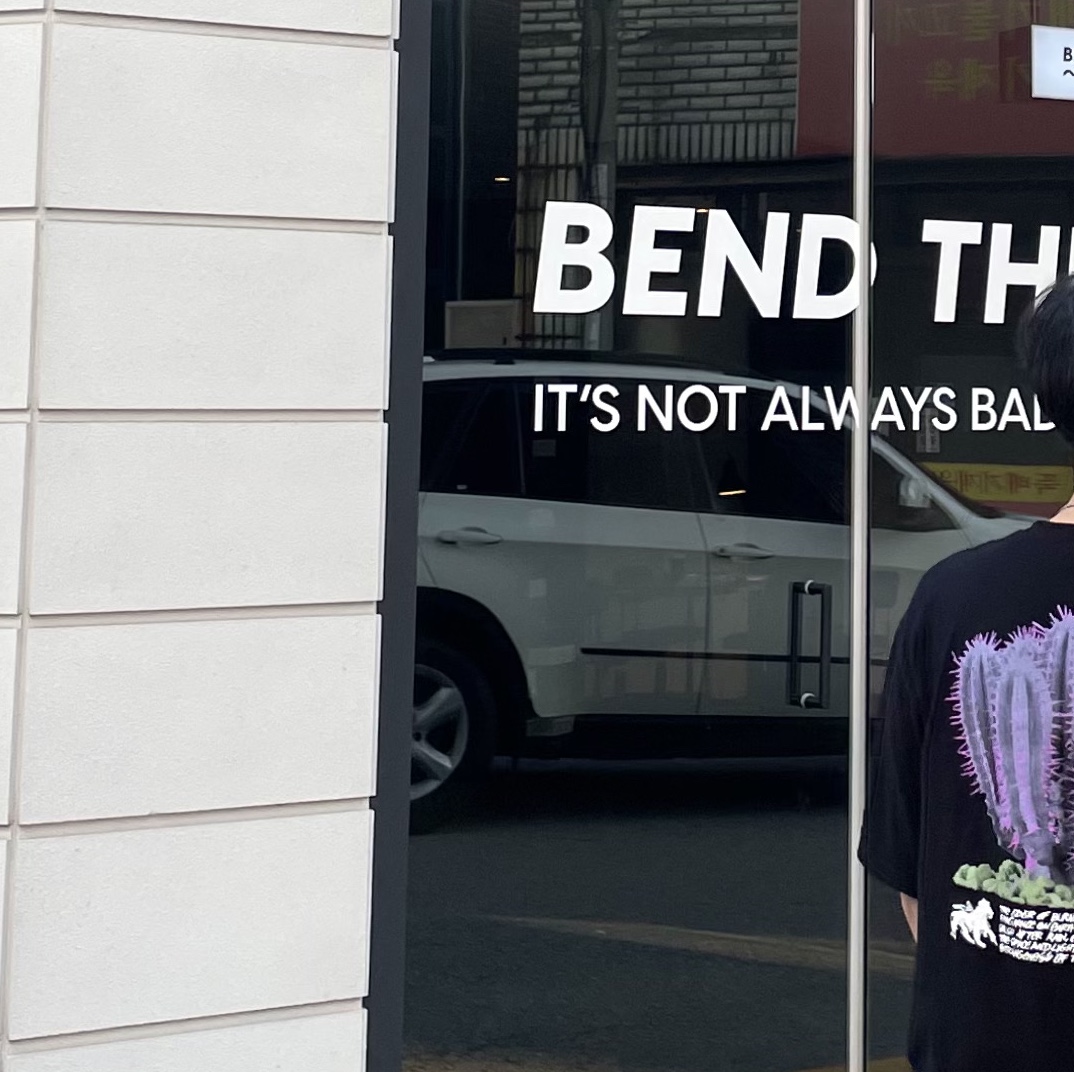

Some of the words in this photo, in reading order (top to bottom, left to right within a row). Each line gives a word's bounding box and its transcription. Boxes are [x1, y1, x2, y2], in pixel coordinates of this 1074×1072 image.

[533, 200, 877, 319] BEND
[637, 385, 747, 432] NOT
[761, 385, 957, 432] ALWAYS
